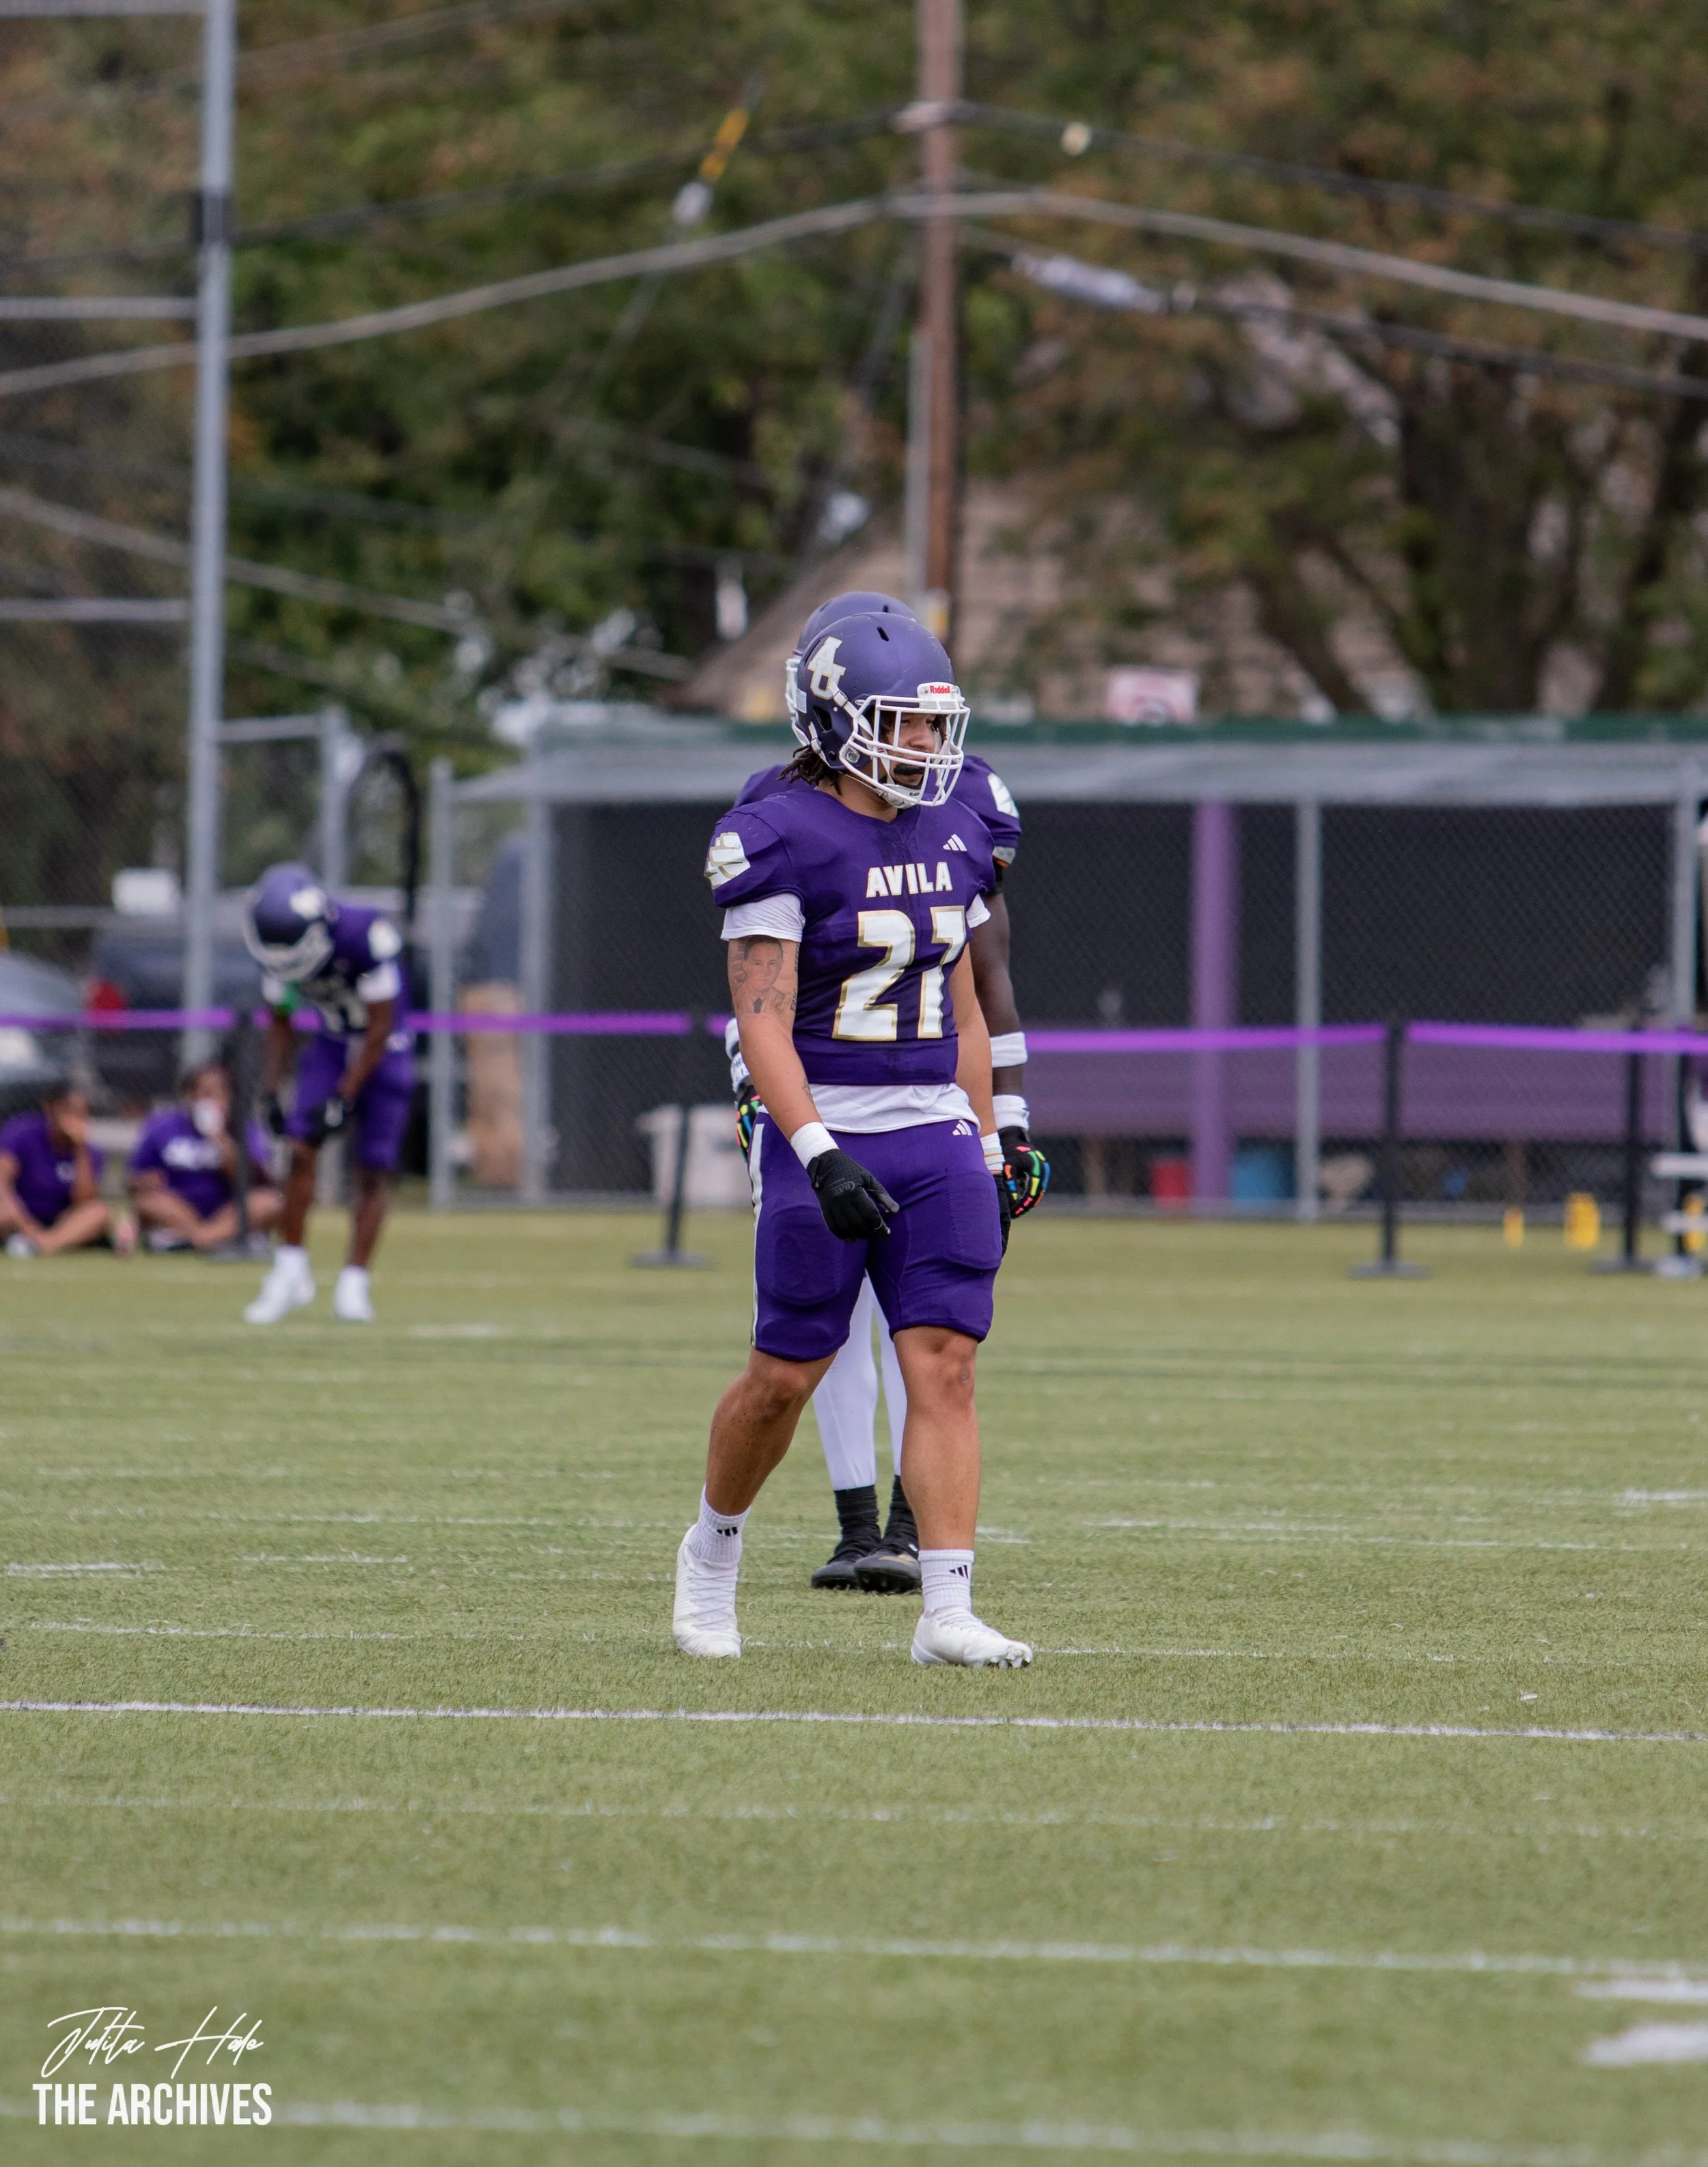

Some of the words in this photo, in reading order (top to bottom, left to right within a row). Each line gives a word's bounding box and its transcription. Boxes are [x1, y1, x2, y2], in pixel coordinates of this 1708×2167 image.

[808, 636, 846, 700] AU
[929, 685, 951, 694] Riddell
[866, 861, 954, 898] AVILA
[831, 905, 966, 1041] 27
